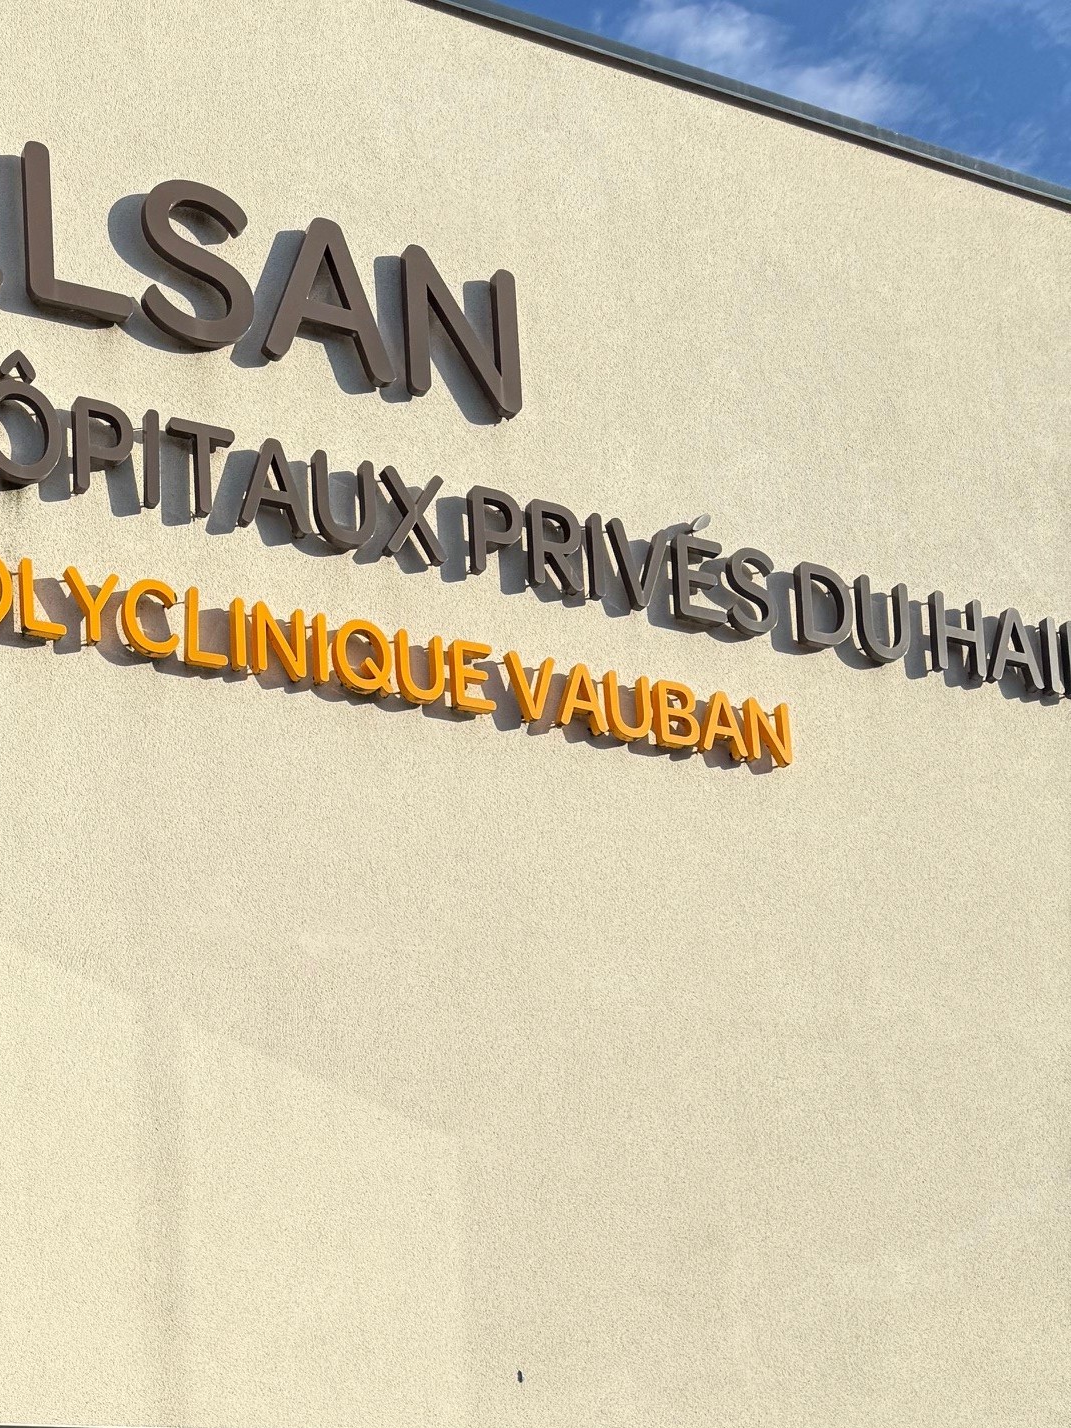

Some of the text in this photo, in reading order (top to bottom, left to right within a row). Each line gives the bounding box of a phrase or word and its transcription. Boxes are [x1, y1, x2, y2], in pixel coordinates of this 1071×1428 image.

[466, 484, 778, 636] PRIVÉS
[793, 561, 911, 664] DU
[927, 589, 1071, 700] HAI
[502, 650, 792, 767] VAUBAN
